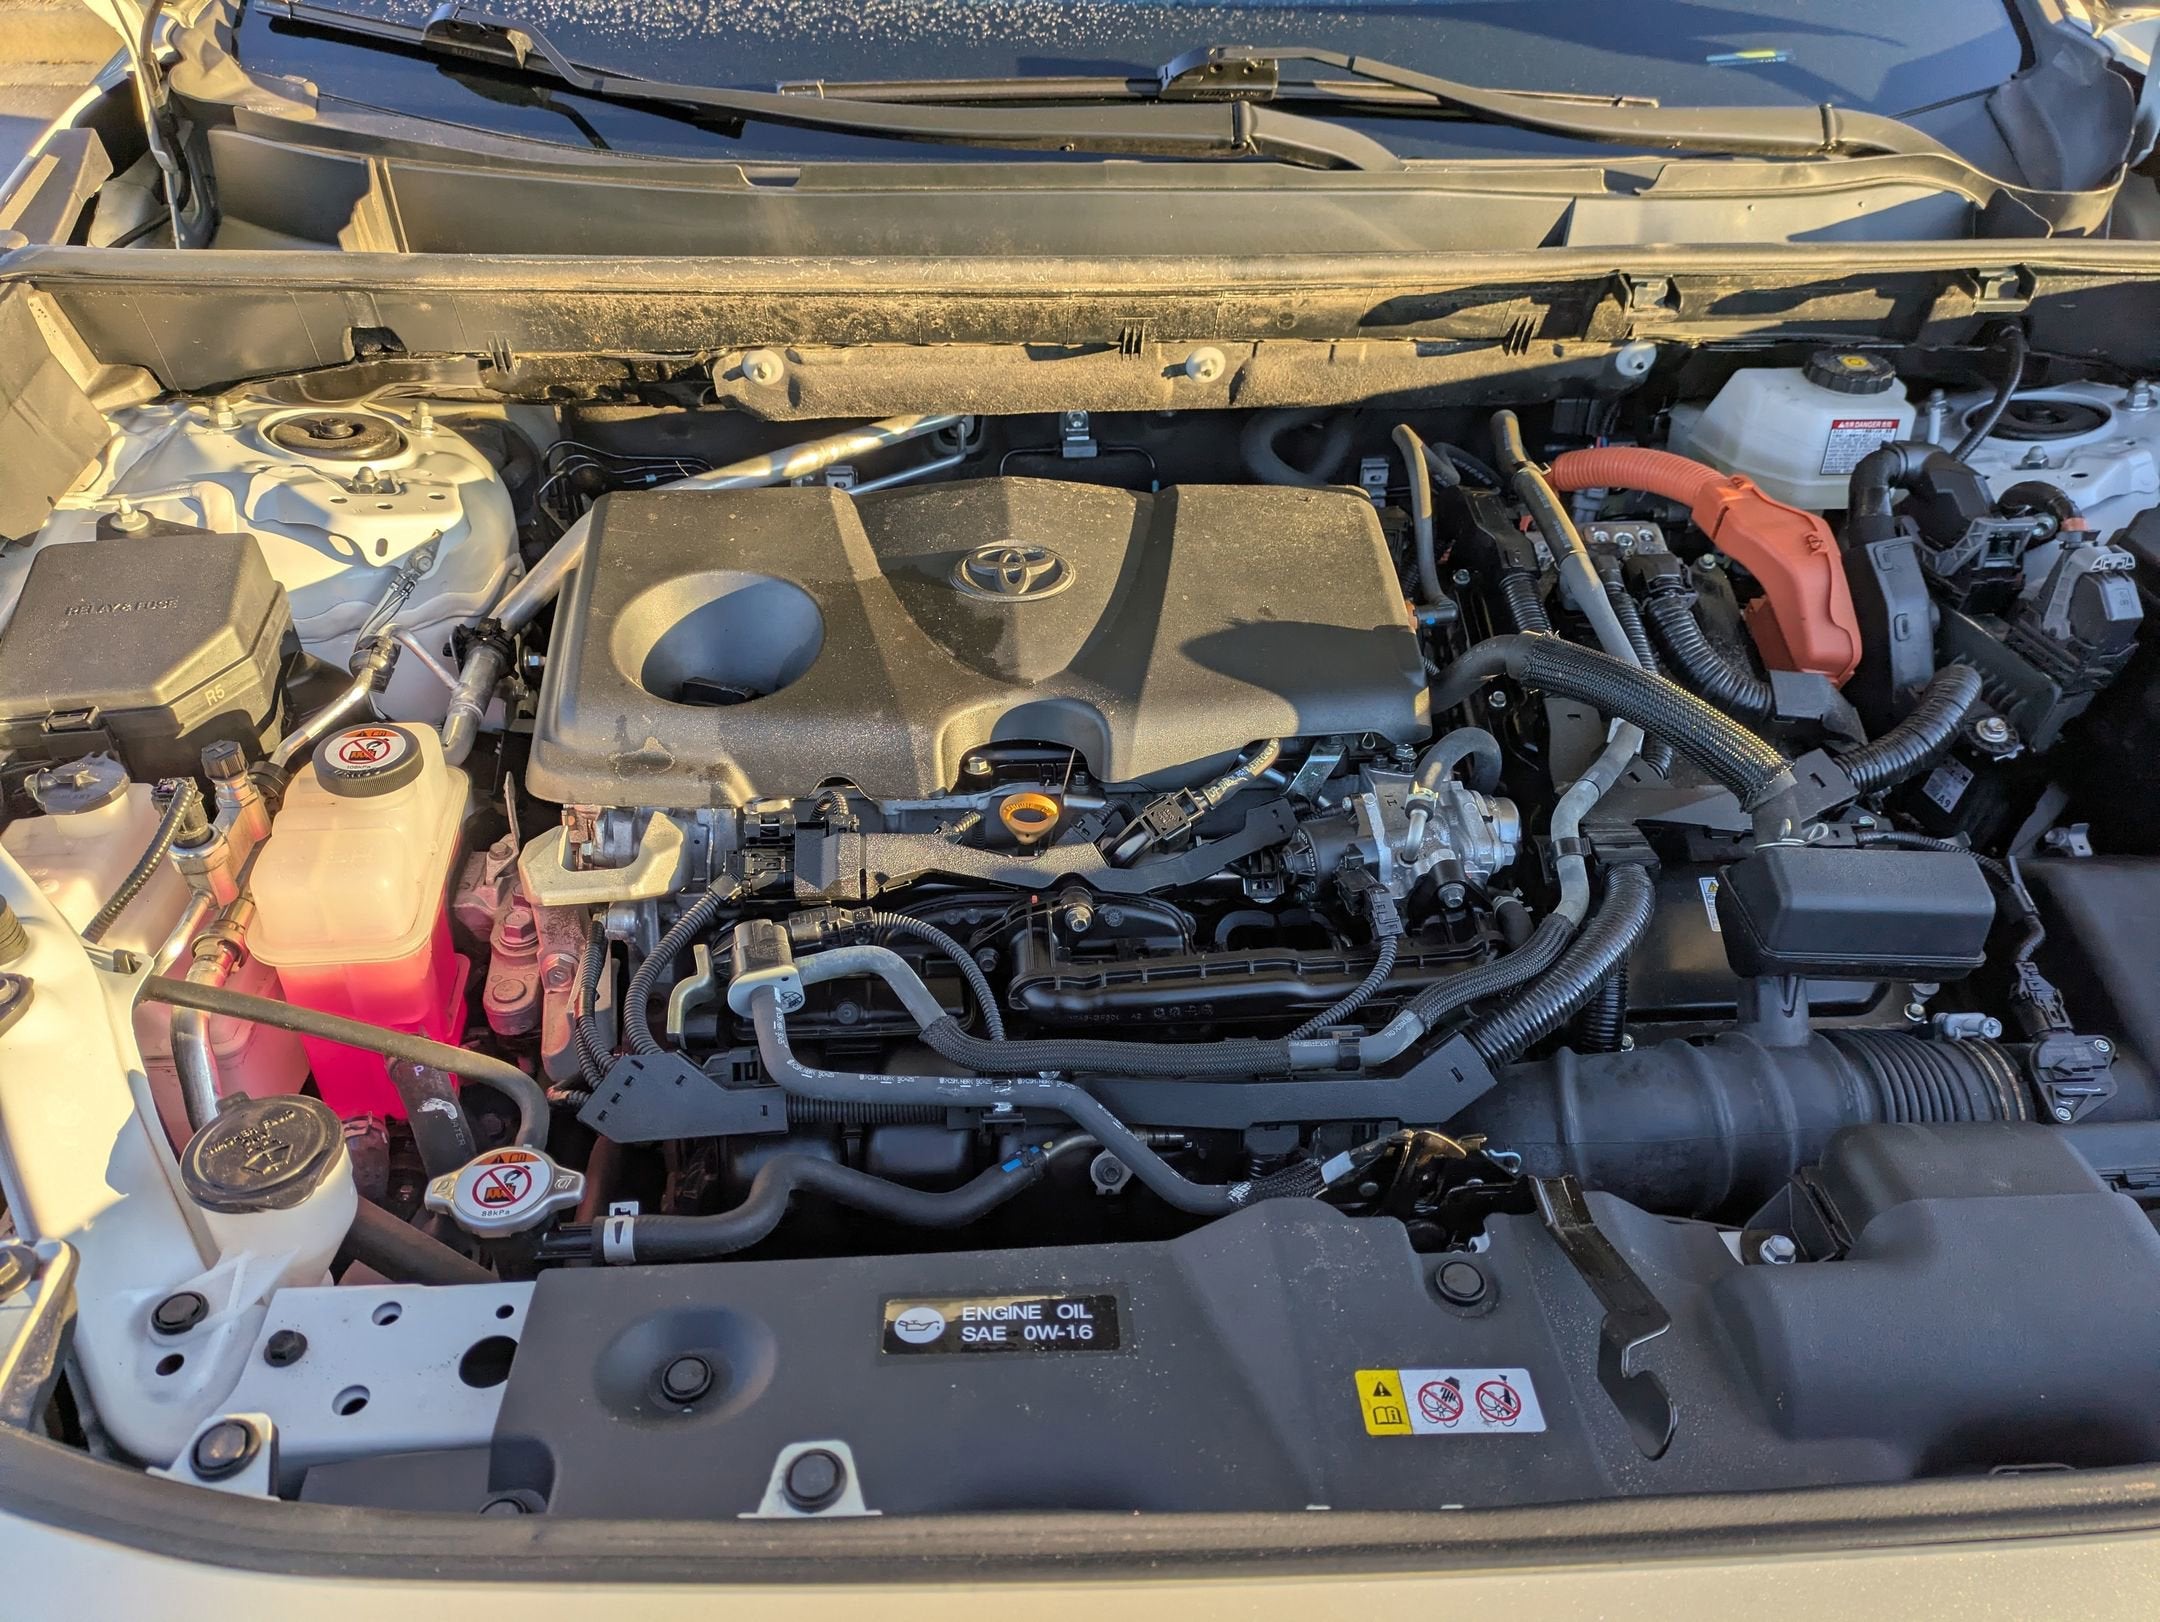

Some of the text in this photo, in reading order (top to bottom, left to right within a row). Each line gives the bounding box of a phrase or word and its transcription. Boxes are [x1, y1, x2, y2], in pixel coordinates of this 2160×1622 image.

[1854, 421, 1881, 429] DANGER
[204, 683, 226, 706] R5
[413, 1064, 425, 1077] P
[481, 1209, 510, 1218] 88kPa
[962, 1303, 1093, 1321] ENGINE OIL
[961, 1324, 1093, 1342] SAE 0W-16
